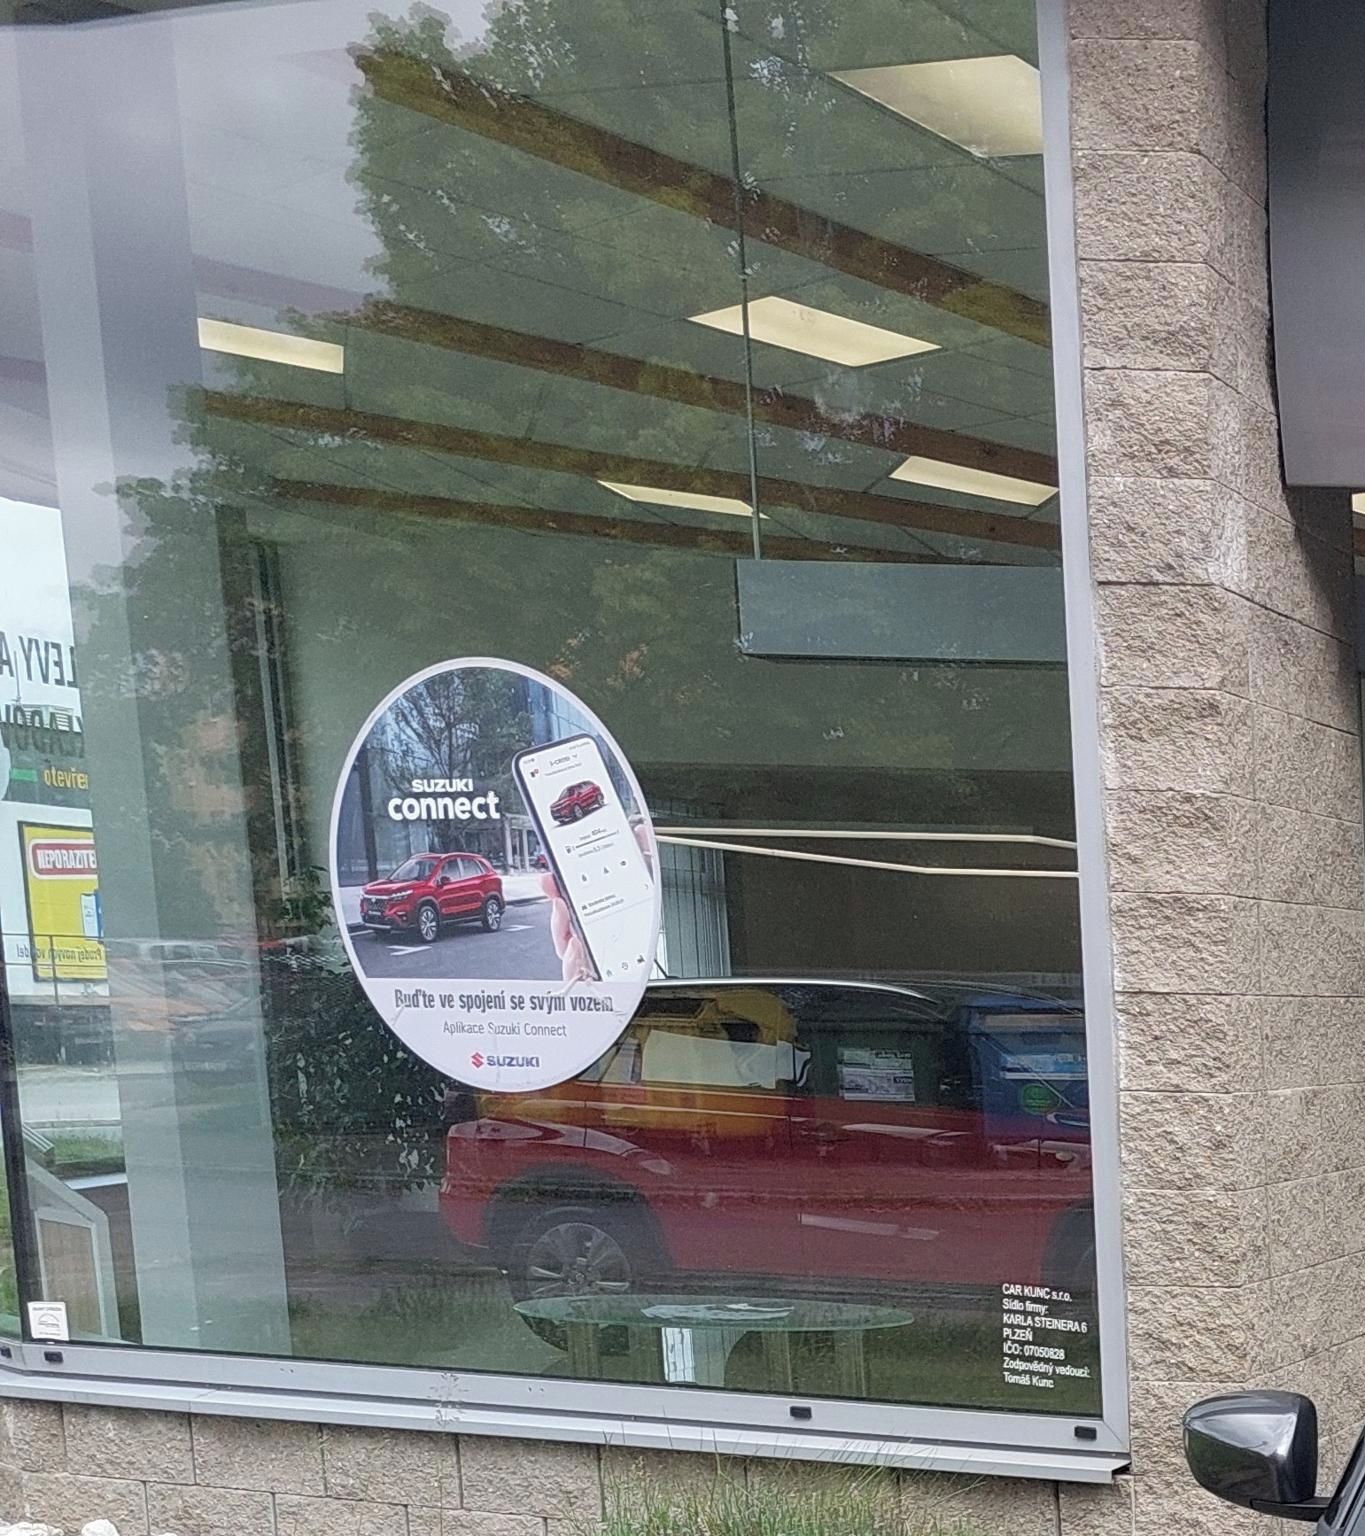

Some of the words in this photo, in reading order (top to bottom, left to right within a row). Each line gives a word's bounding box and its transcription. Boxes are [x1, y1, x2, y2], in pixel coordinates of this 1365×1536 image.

[411, 778, 474, 793] SUZUKI
[388, 790, 501, 821] connect
[394, 988, 436, 1008] Buďte
[438, 994, 456, 1009] ve
[459, 990, 506, 1013] spojení
[510, 997, 526, 1011] se
[529, 991, 566, 1015] svým
[569, 996, 614, 1013] vozem
[443, 1020, 485, 1036] Aplikace
[487, 1022, 521, 1036] Suzuki
[523, 1023, 568, 1038] Connect
[486, 1055, 541, 1068] SUZUKI
[1002, 1283, 1022, 1296] CAR
[1024, 1286, 1051, 1300] KUNC
[1051, 1291, 1073, 1302] s.r.o.
[1002, 1298, 1024, 1311] Sídlo
[1026, 1301, 1049, 1316] firmy:
[1003, 1313, 1033, 1327] KARLA
[1034, 1316, 1081, 1333] STEINERA
[1081, 1322, 1088, 1334] 6
[1002, 1328, 1033, 1342] PLZEŇ
[1003, 1341, 1023, 1355] IČO:
[1003, 1357, 1055, 1376] Zodpovědný
[1055, 1364, 1091, 1378] vedoucí:
[1003, 1371, 1031, 1386] Tomáš
[1031, 1375, 1055, 1388] Kunc
